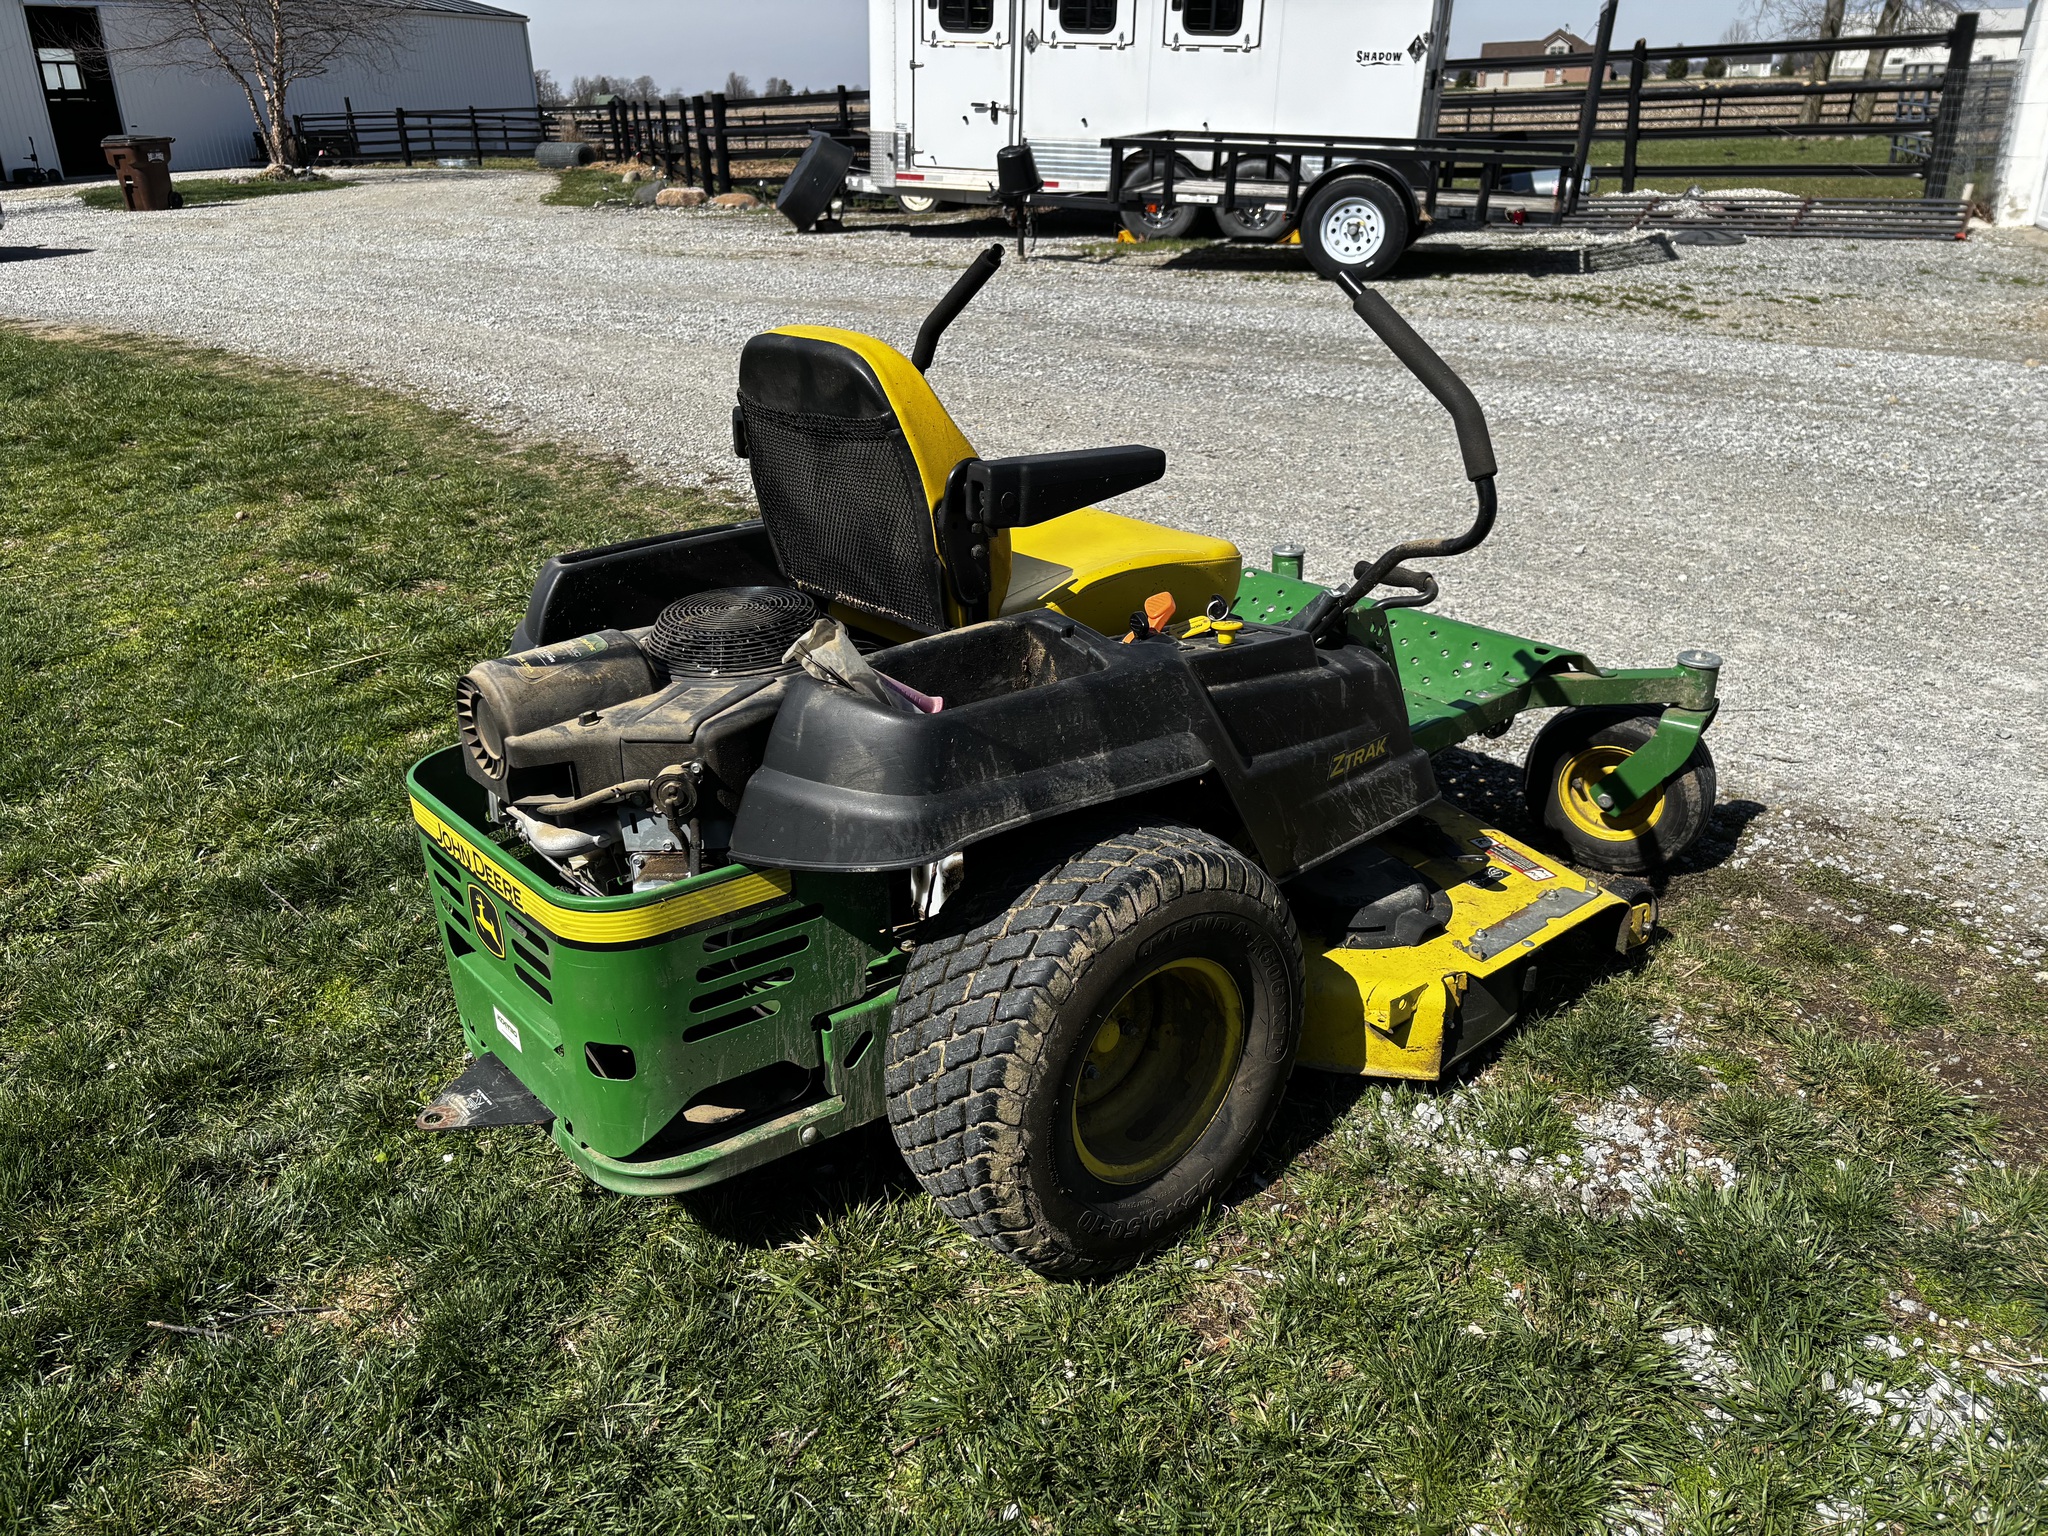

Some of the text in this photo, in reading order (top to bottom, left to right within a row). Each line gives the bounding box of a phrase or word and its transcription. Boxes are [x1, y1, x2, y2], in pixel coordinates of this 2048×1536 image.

[1356, 50, 1403, 63] SHADOW
[1329, 736, 1388, 779] ZTRAK
[436, 822, 526, 912] JOHN DEERE
[1247, 933, 1287, 998] K506
